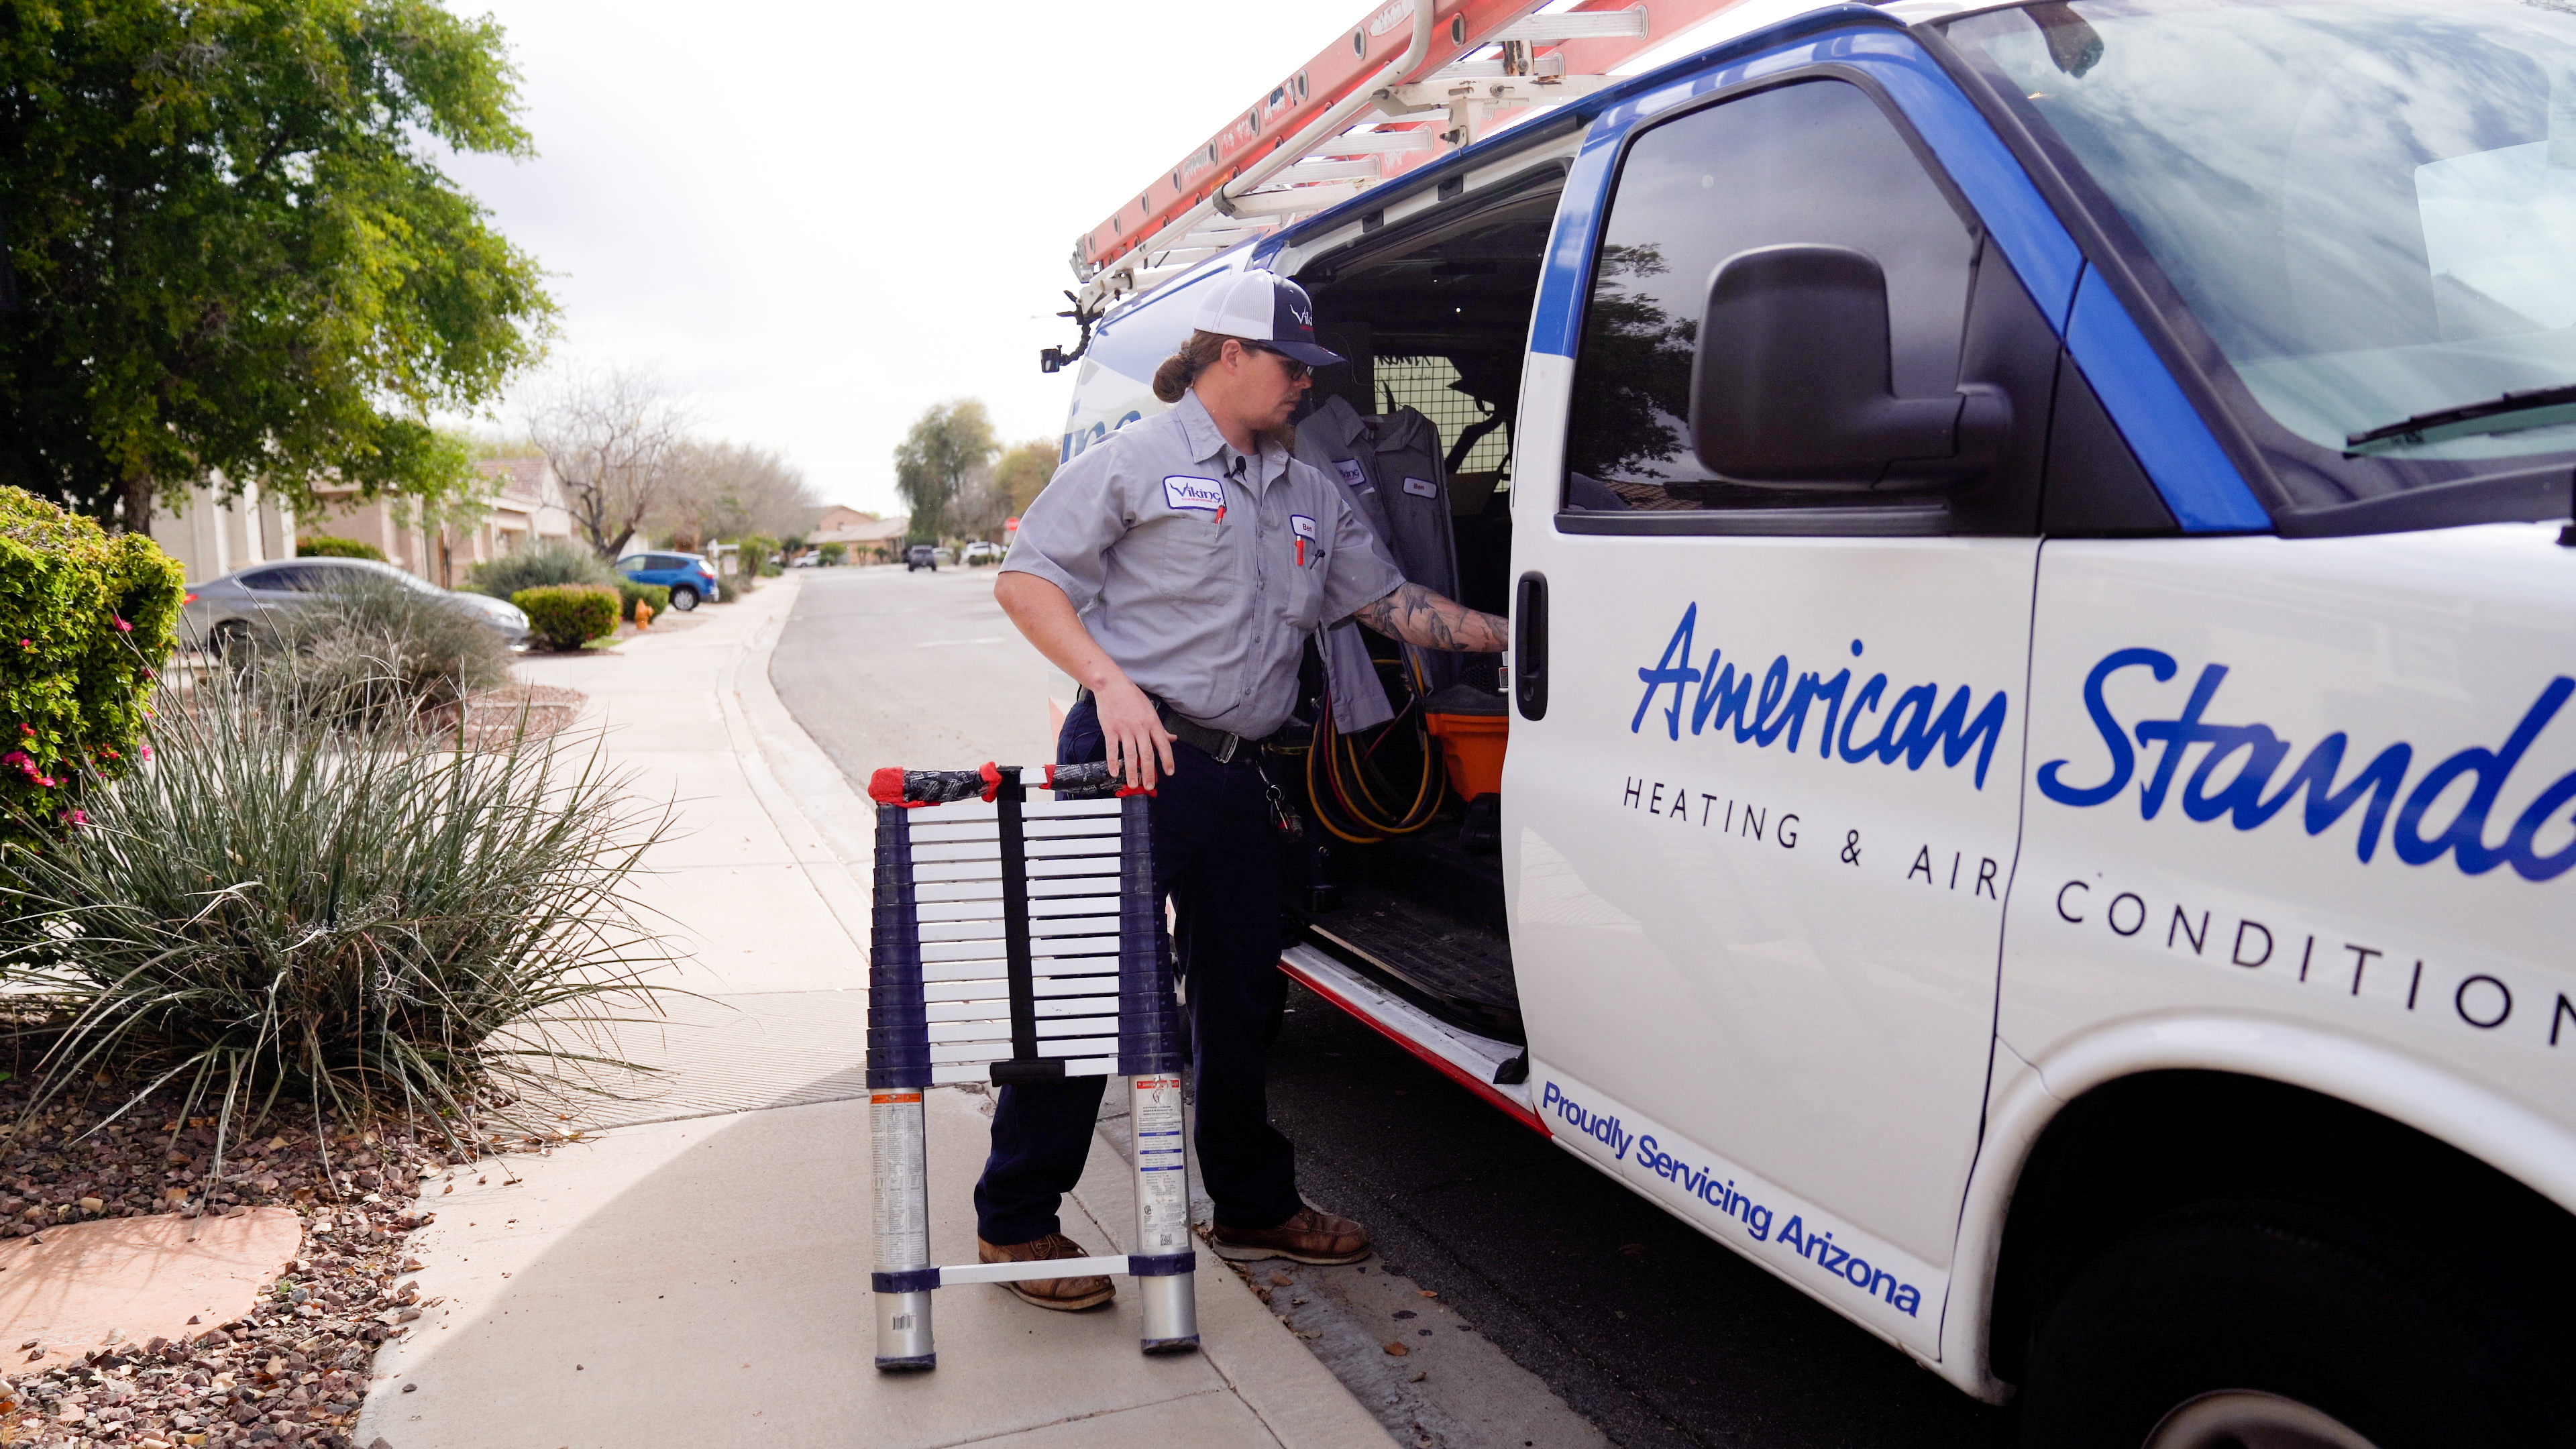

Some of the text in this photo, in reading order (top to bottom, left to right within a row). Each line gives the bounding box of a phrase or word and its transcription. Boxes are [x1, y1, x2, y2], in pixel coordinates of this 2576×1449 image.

[1169, 482, 1222, 503] Viking
[1413, 482, 1425, 490] Ben
[1302, 523, 1313, 533] Ben
[1630, 600, 2008, 791] American
[1623, 775, 1800, 849] HEATING
[1840, 828, 1862, 866] &
[1907, 844, 1998, 900] AIR
[1543, 1081, 1922, 1319] Proudly Servicing Arizona
